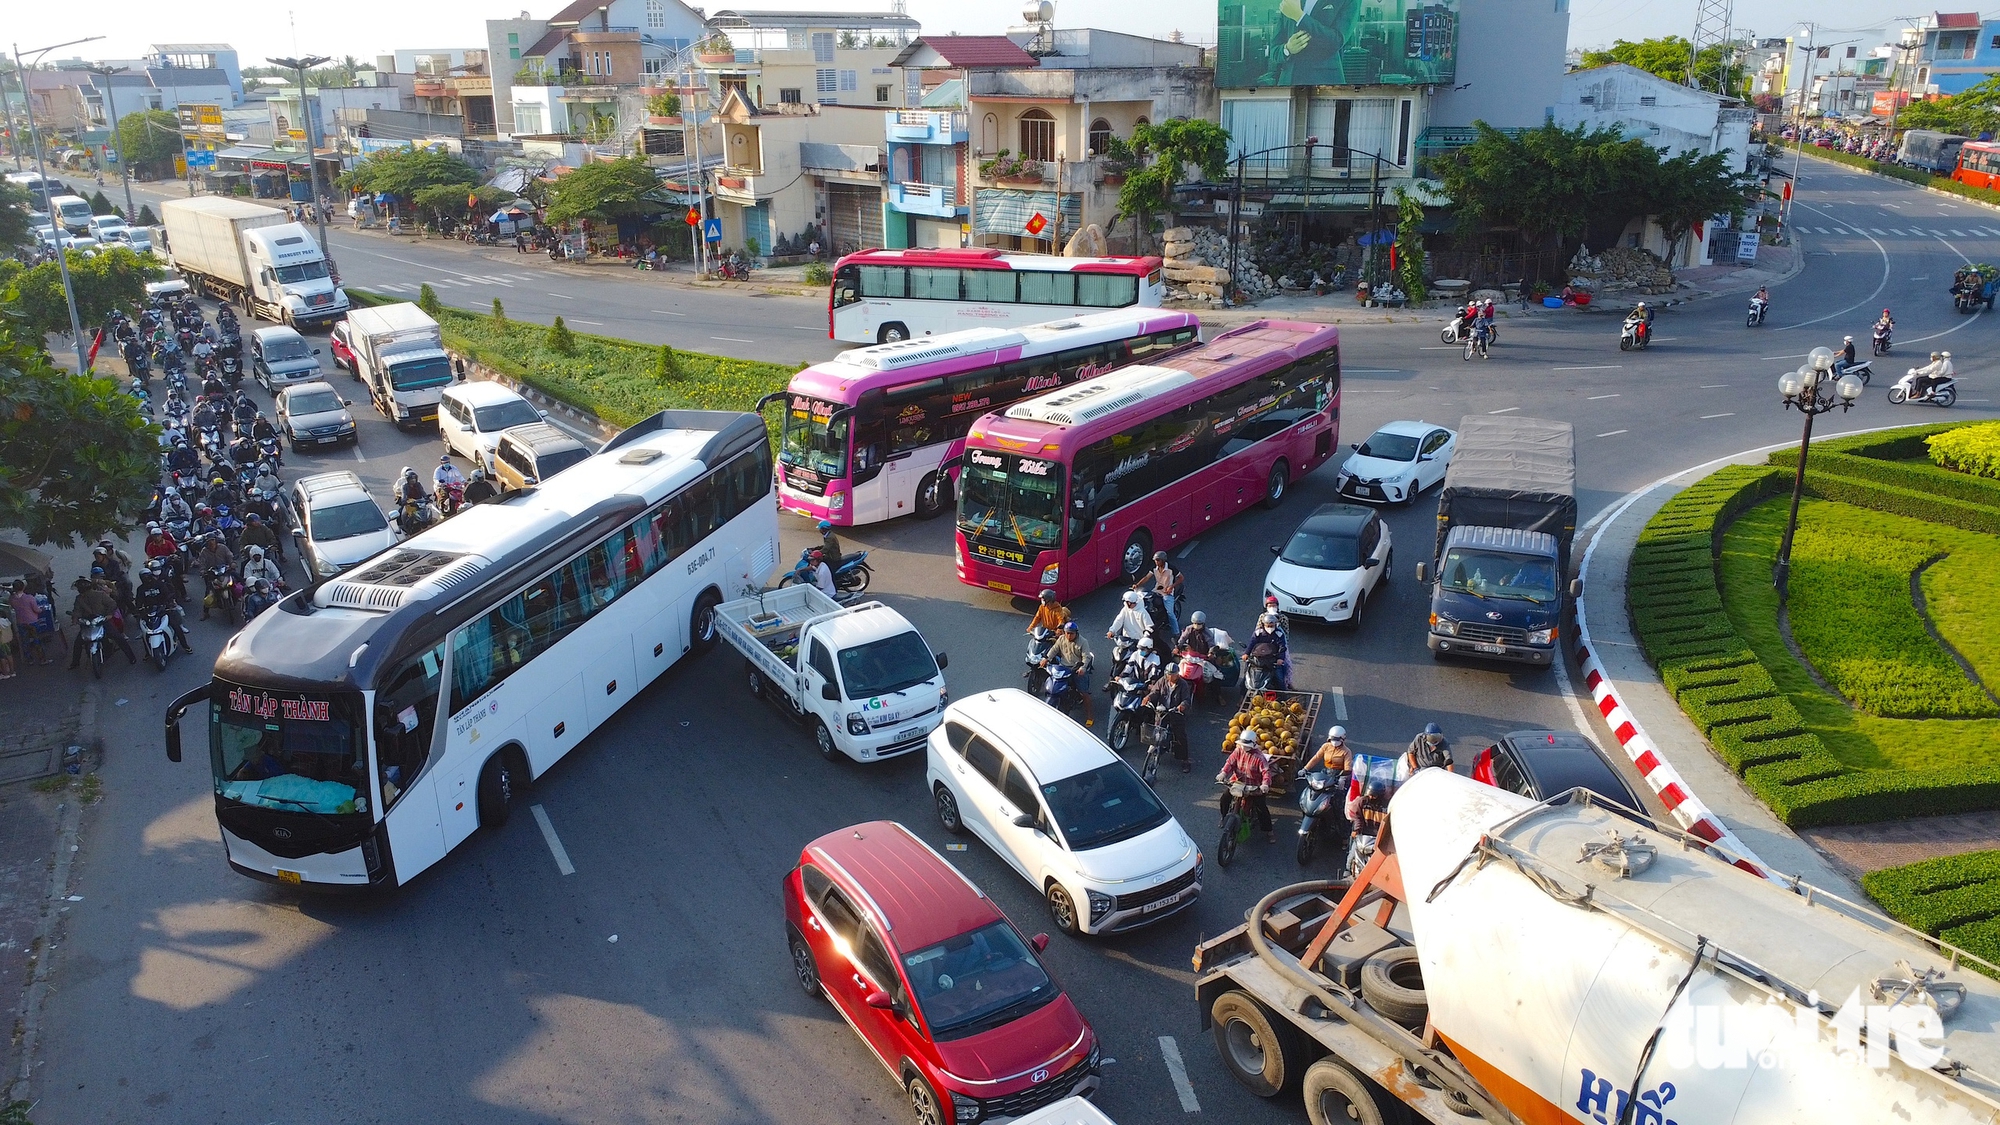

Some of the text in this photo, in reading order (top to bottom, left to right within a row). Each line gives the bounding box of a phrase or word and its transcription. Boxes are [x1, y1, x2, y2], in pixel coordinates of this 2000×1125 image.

[1021, 372, 1062, 393] Minh
[952, 392, 972, 402] NEW
[229, 687, 330, 721] TÂN LẬP THÀNH
[274, 828, 289, 838] KIA
